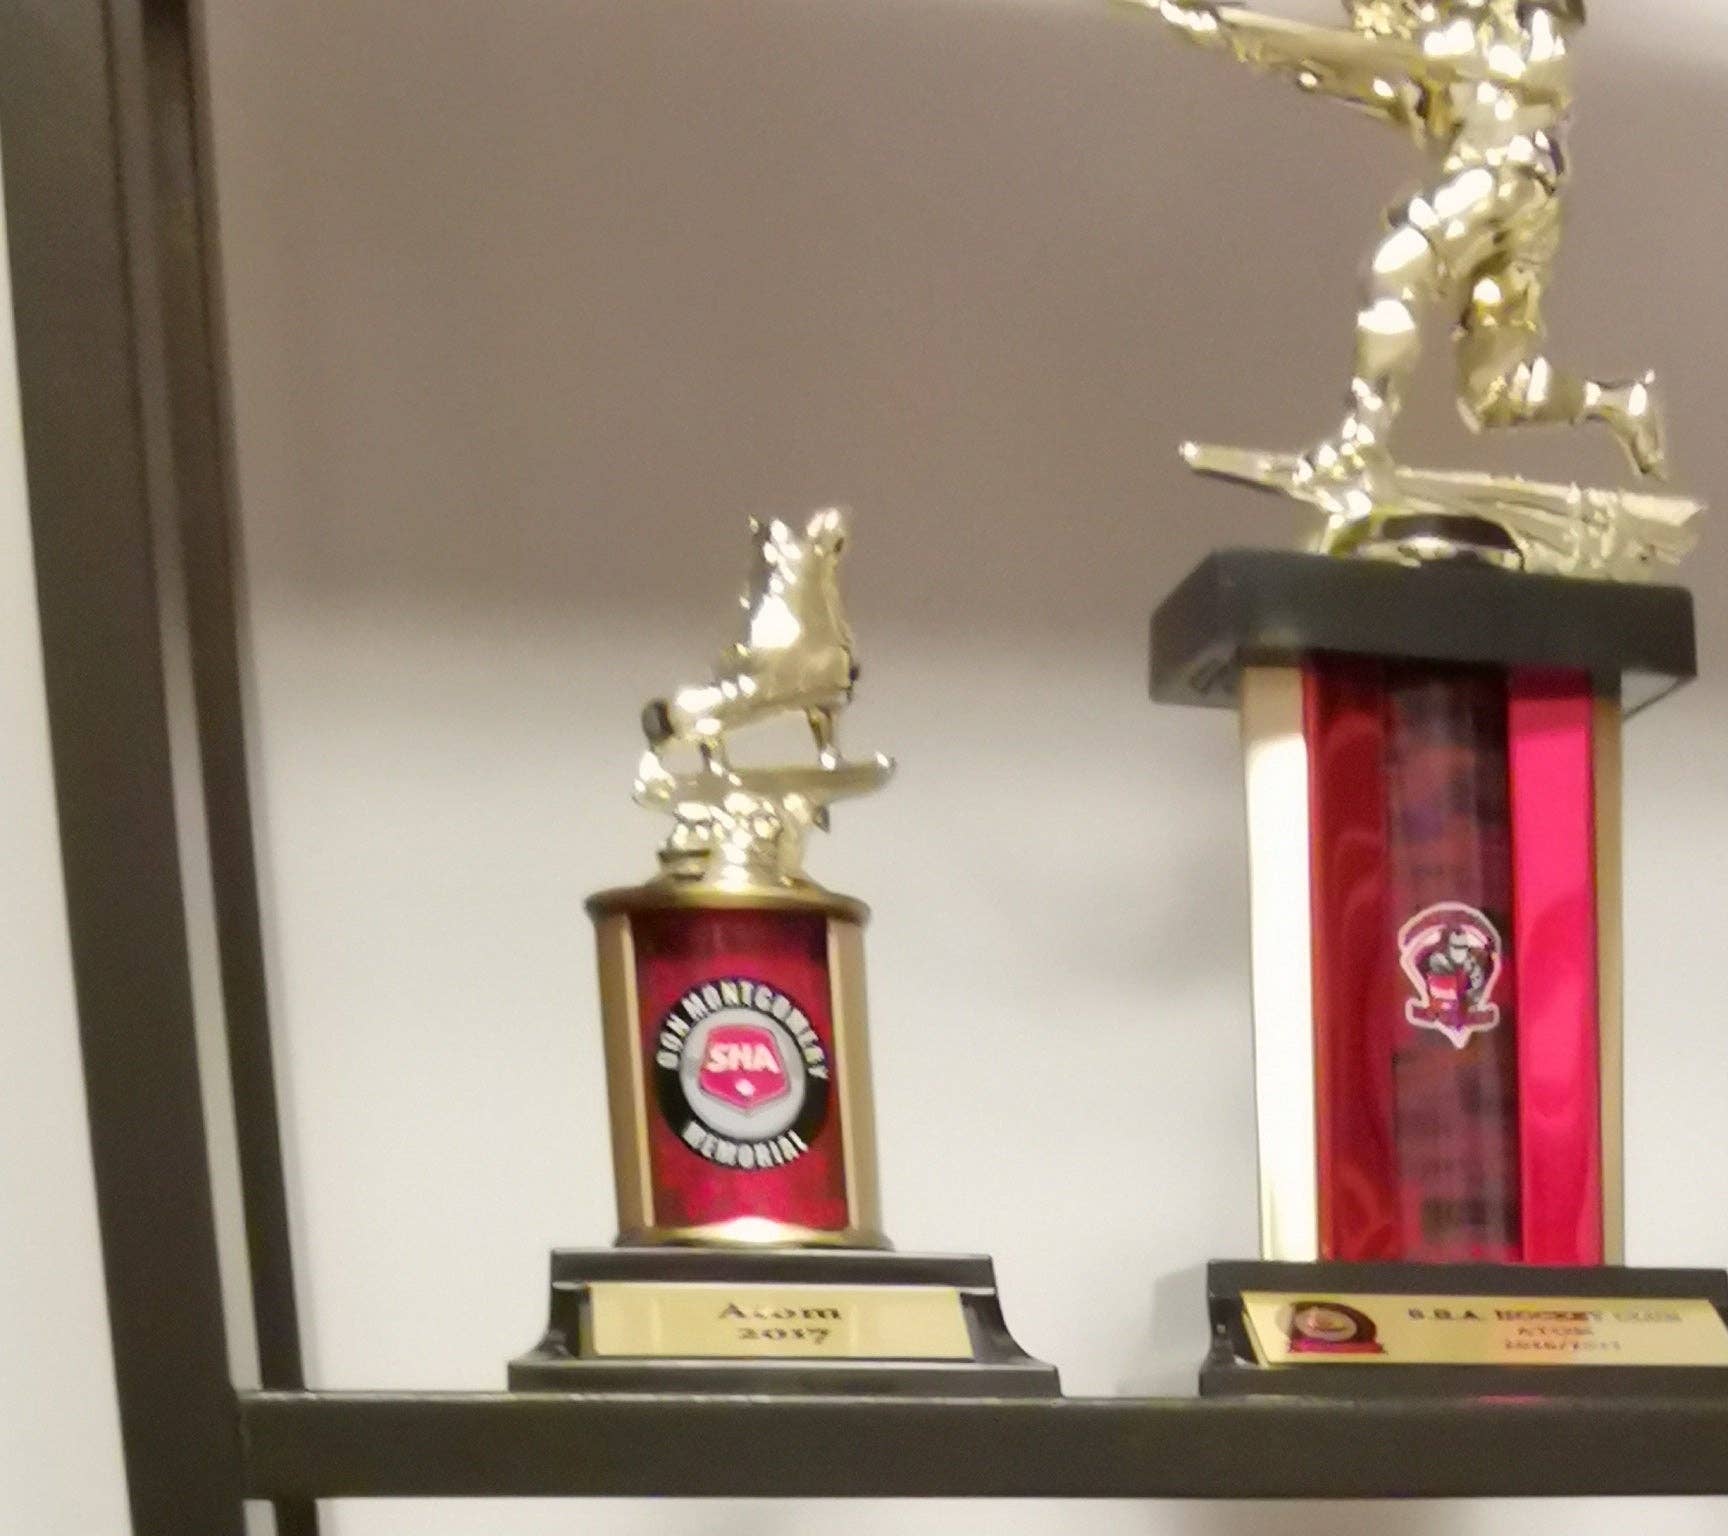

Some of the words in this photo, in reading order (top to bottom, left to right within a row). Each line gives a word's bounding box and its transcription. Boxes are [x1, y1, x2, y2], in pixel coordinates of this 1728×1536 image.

[682, 1121, 808, 1169] MEMORIAL
[718, 1302, 842, 1319] Atom
[739, 1326, 829, 1345] 2017
